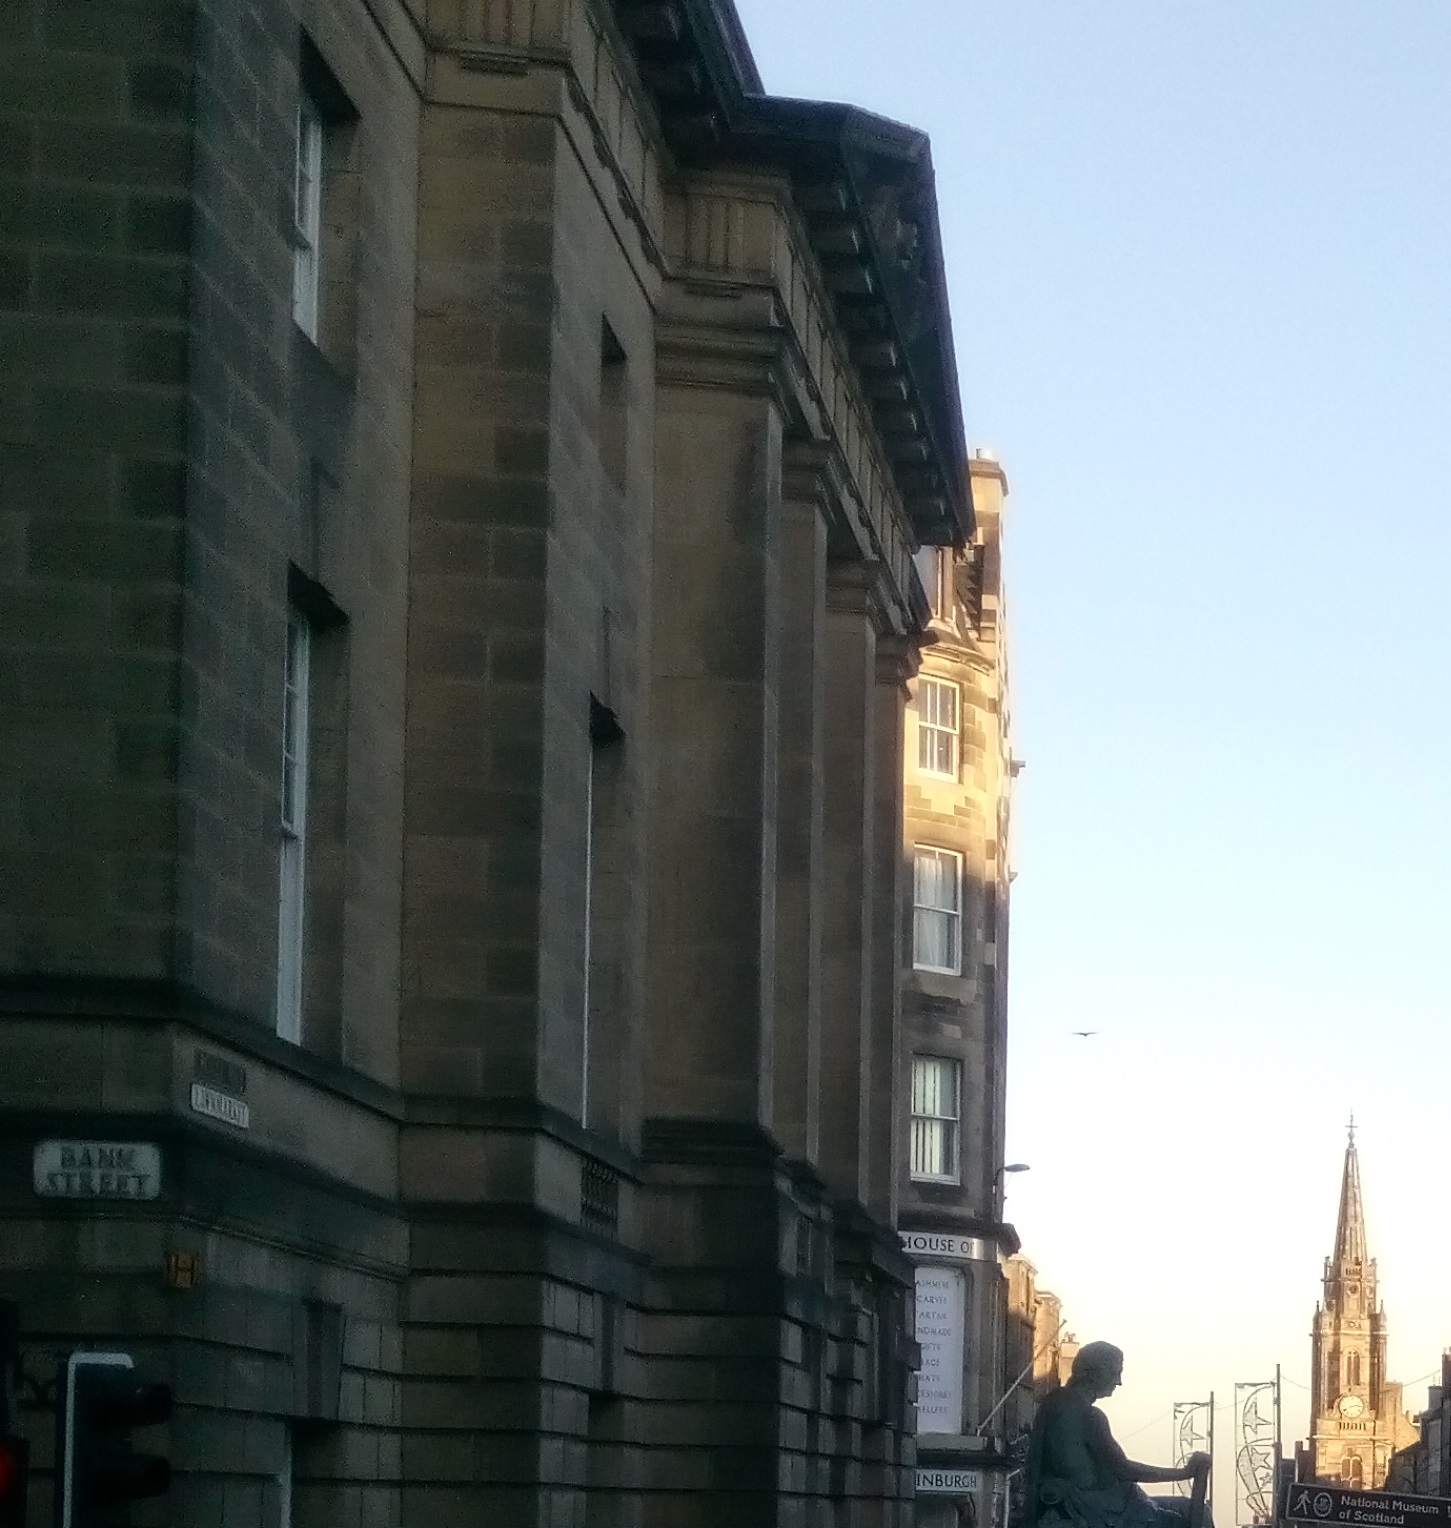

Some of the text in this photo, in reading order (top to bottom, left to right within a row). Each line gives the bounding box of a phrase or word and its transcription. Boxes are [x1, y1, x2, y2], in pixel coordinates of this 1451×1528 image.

[61, 1147, 135, 1168] BANK
[46, 1173, 151, 1195] STREET
[900, 1236, 955, 1253] HOUSE
[1341, 1495, 1390, 1510] National
[1392, 1500, 1439, 1515] Museum
[1339, 1510, 1404, 1525] of Scotland
